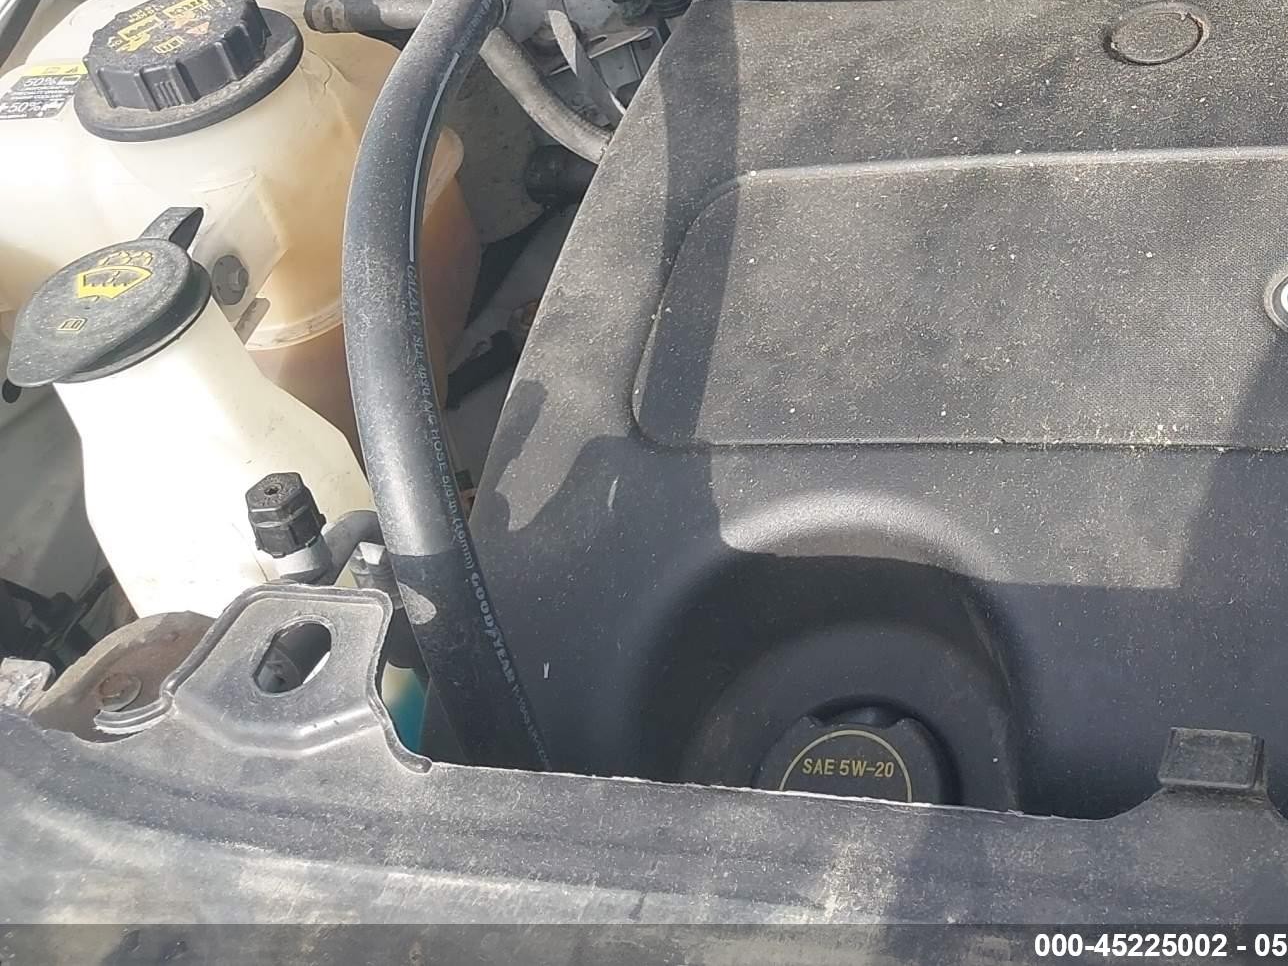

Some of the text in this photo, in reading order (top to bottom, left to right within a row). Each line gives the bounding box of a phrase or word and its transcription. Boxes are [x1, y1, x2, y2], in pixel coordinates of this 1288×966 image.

[431, 427, 449, 471] HOSE
[471, 572, 516, 683] GOODYEAR
[802, 758, 895, 778] SAE 5W-20
